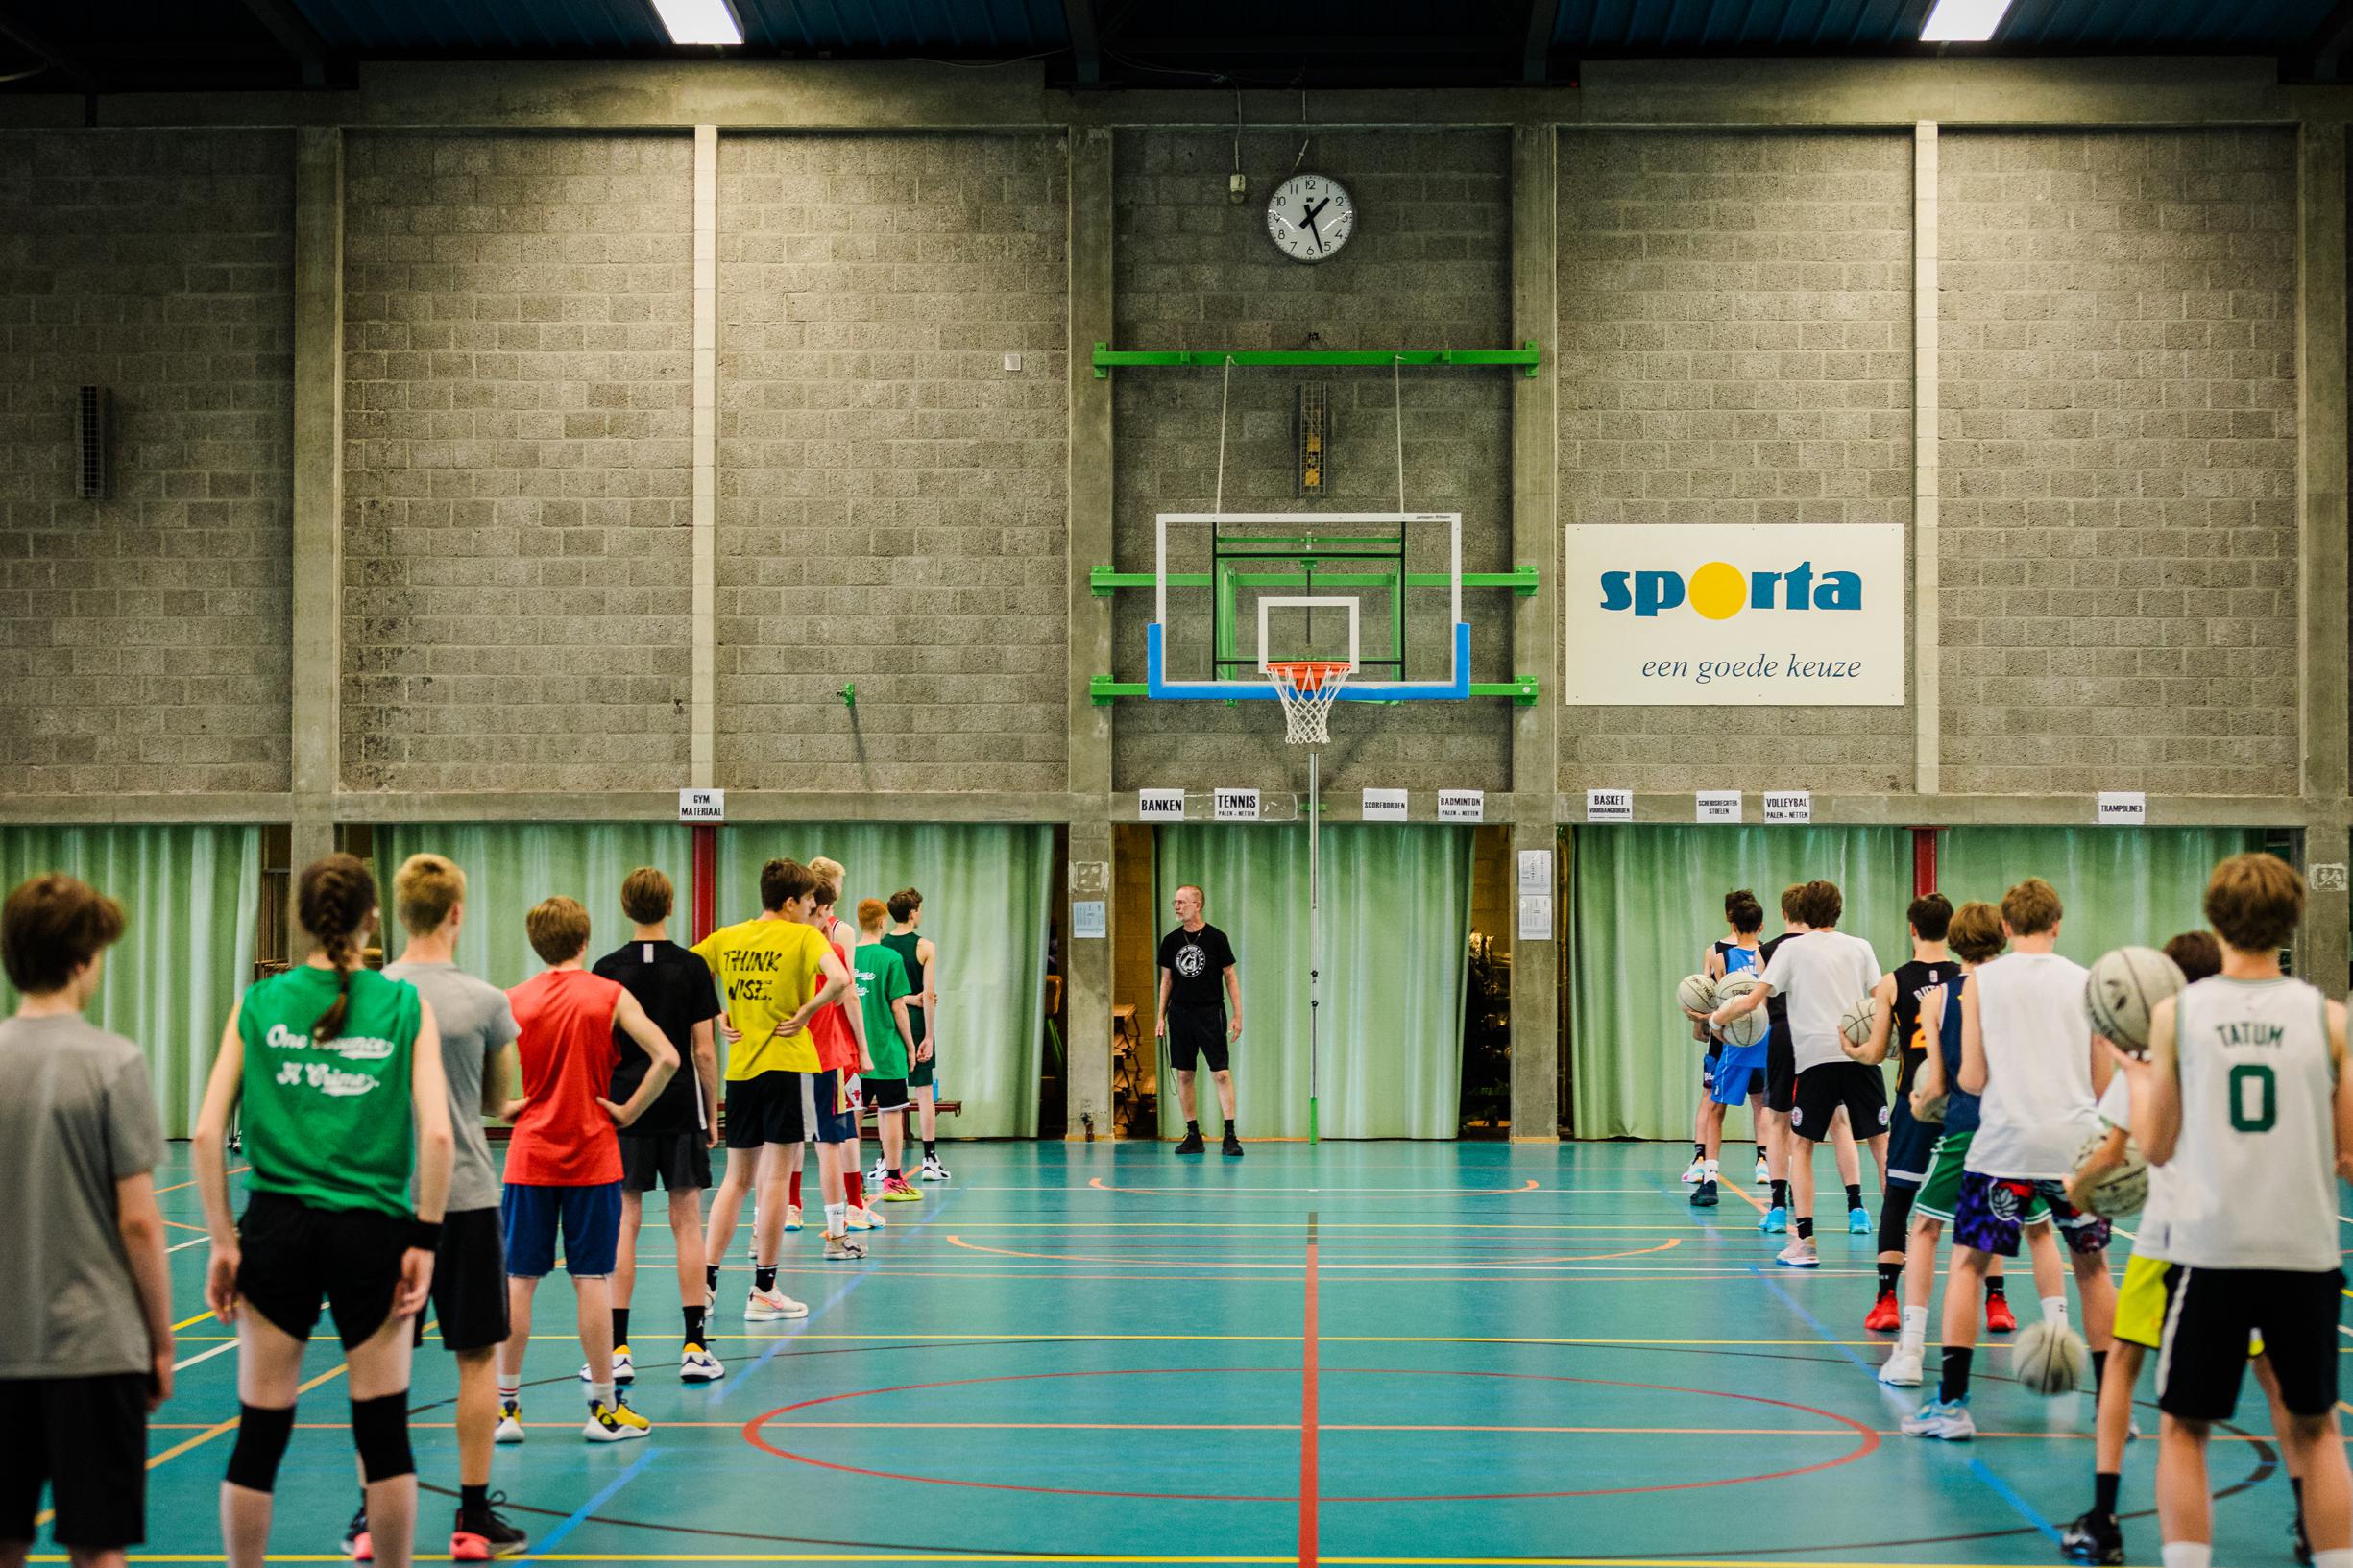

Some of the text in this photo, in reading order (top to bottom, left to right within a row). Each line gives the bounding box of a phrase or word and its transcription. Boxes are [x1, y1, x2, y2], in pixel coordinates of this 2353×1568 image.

[1290, 183, 1298, 195] 11
[1305, 180, 1316, 190] 12
[1276, 196, 1287, 206] 10
[1335, 196, 1344, 206] 2
[1273, 213, 1281, 223] 9
[1341, 212, 1348, 223] 3
[1277, 229, 1286, 240] 8
[1334, 229, 1343, 239] 4
[1290, 241, 1298, 252] 7
[1306, 246, 1315, 256] 6
[1324, 241, 1332, 252] 5
[1599, 561, 1862, 620] sporta
[1641, 653, 1862, 685] een goede keuze
[693, 794, 711, 804] GYM
[1217, 795, 1256, 808] TENNIS
[1440, 797, 1481, 807] BADMINTON
[1594, 795, 1625, 806] BASKET
[1766, 798, 1808, 808] VOLLEYBAL
[1141, 799, 1182, 811] BANKEN
[1364, 801, 1406, 809] SCOREBORDEN
[2100, 805, 2143, 813] TRAMPOLINES
[681, 807, 722, 816] MATERIAAL
[723, 950, 783, 972] THINK
[266, 1023, 308, 1049] One
[2215, 1022, 2285, 1049] TATUM
[2228, 1063, 2277, 1133] 0
